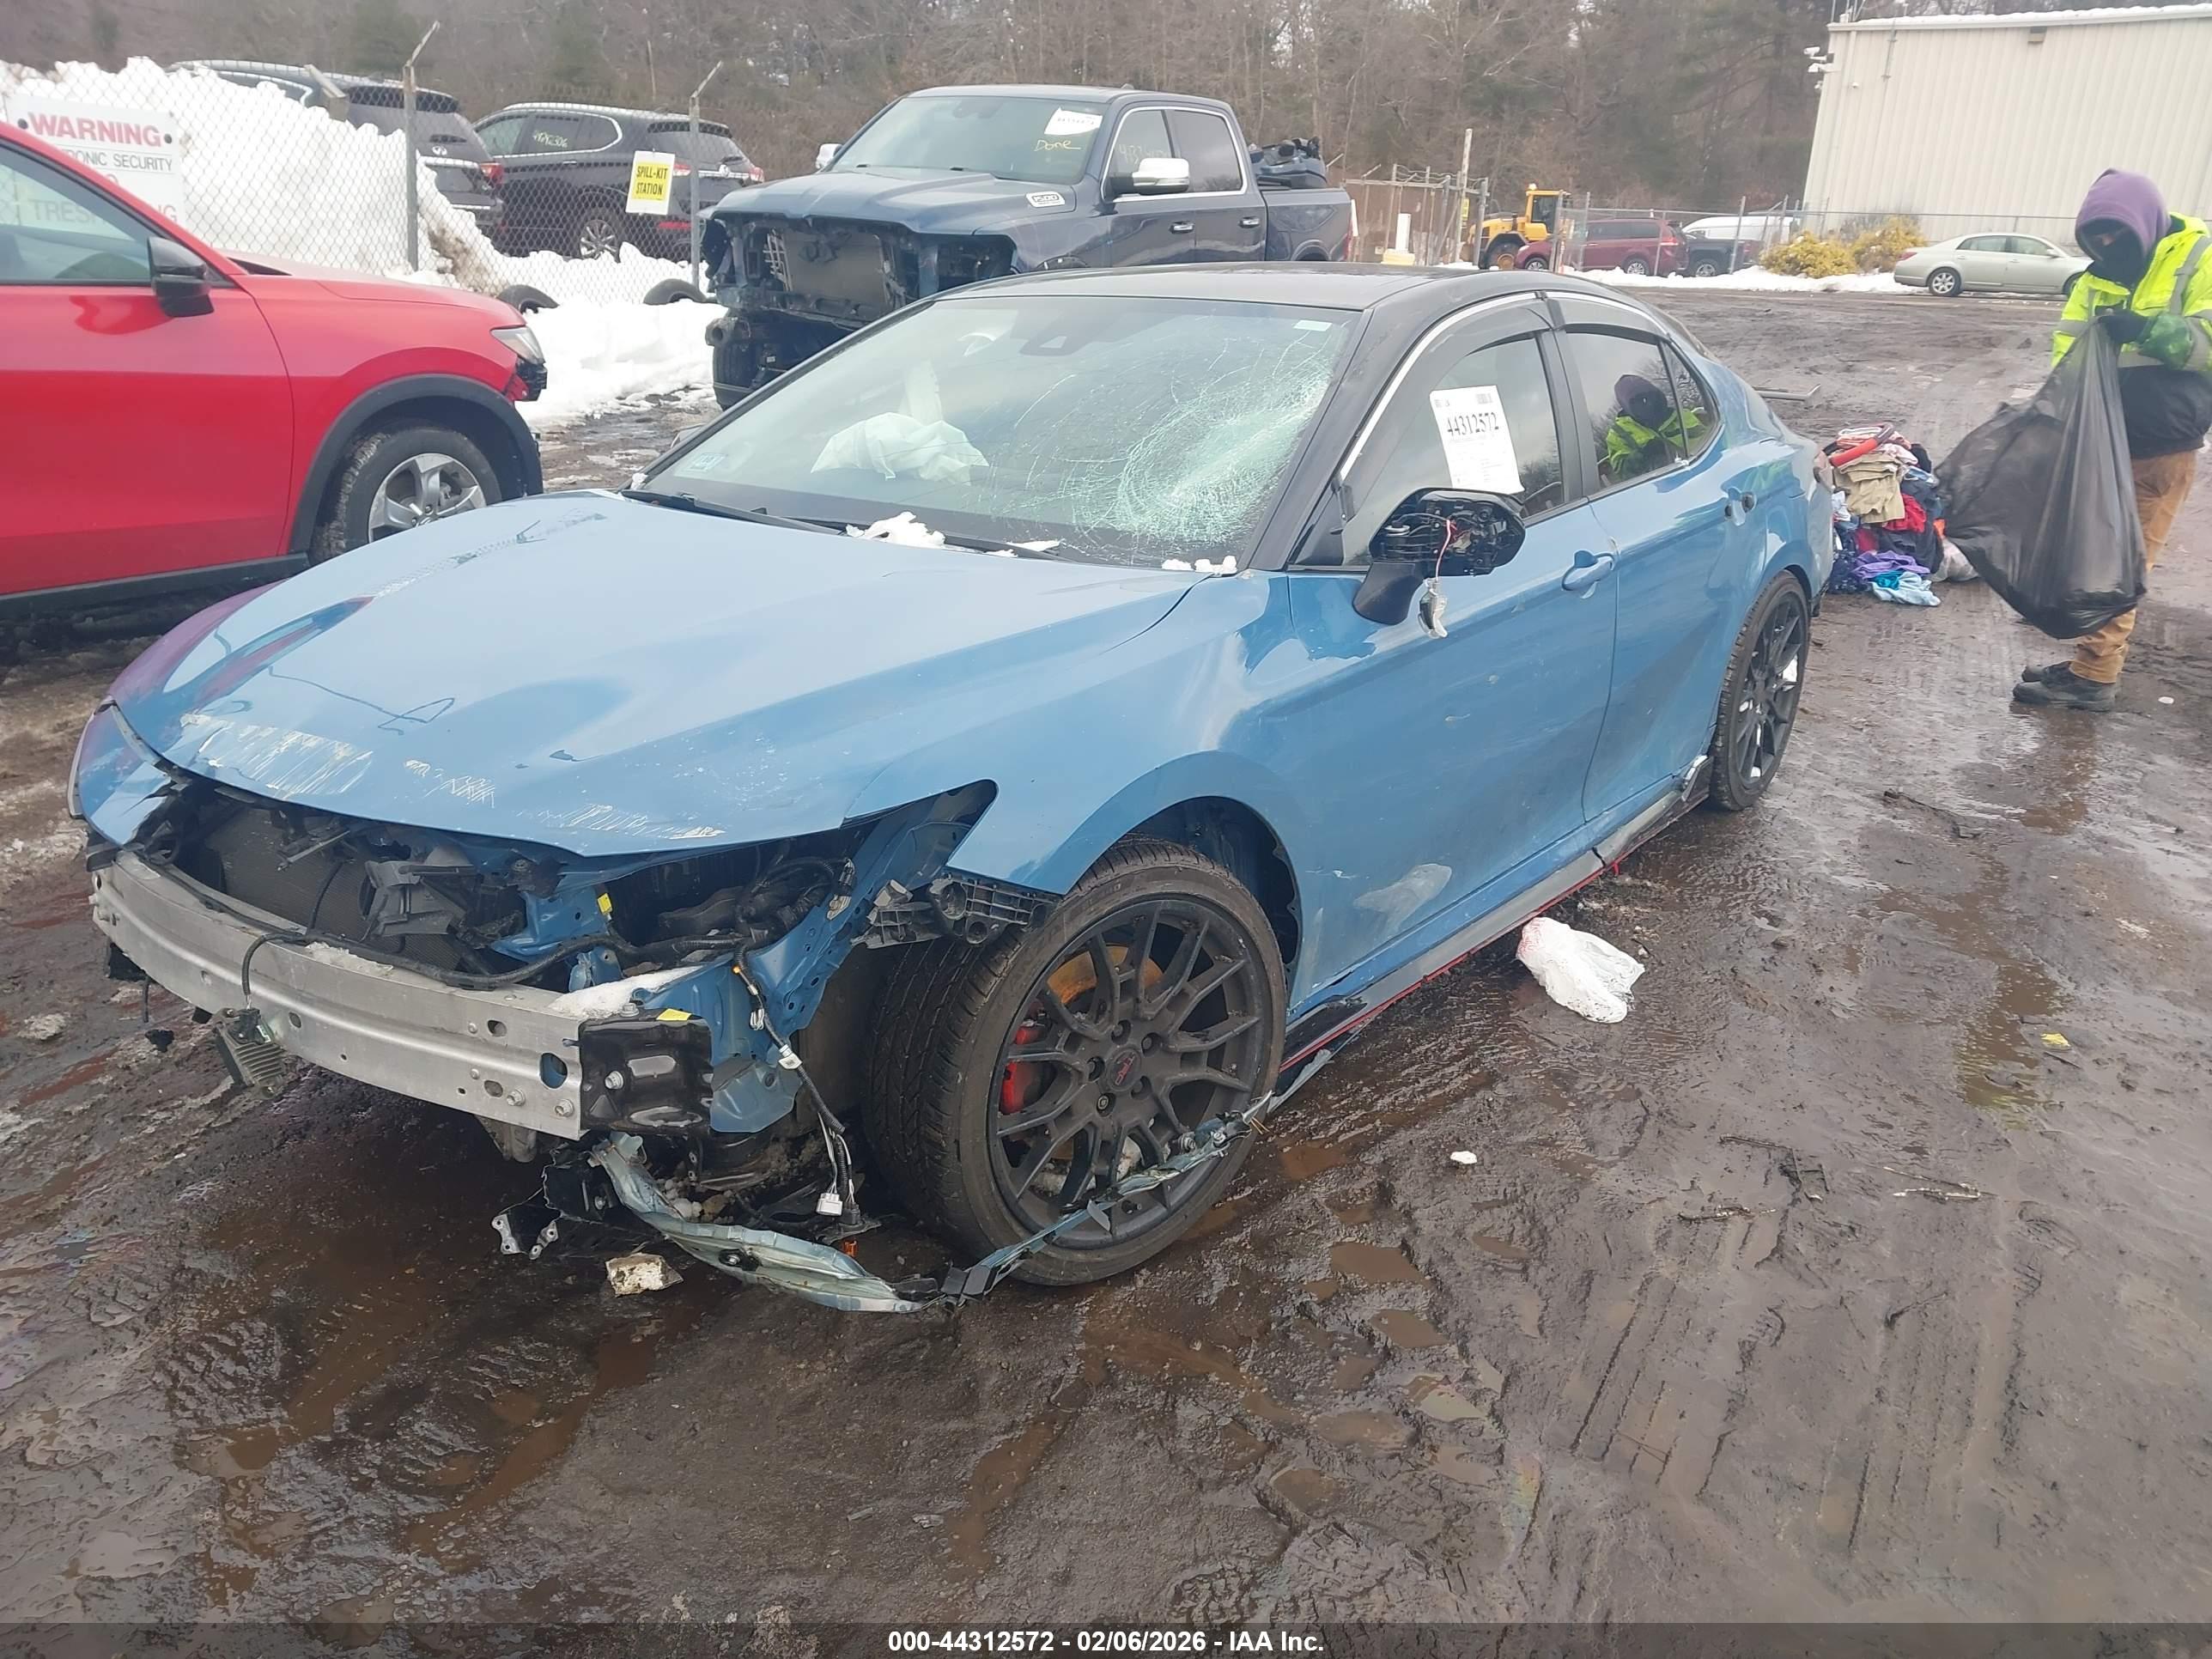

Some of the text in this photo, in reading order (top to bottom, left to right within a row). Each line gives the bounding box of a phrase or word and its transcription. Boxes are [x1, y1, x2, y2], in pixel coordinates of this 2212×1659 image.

[27, 112, 161, 147] WARNING
[1034, 139, 1081, 151] Done
[112, 153, 173, 171] SECURITY
[636, 166, 668, 179] SPILL-KIT
[635, 182, 663, 195] STATION
[1447, 412, 1499, 436] 44312572
